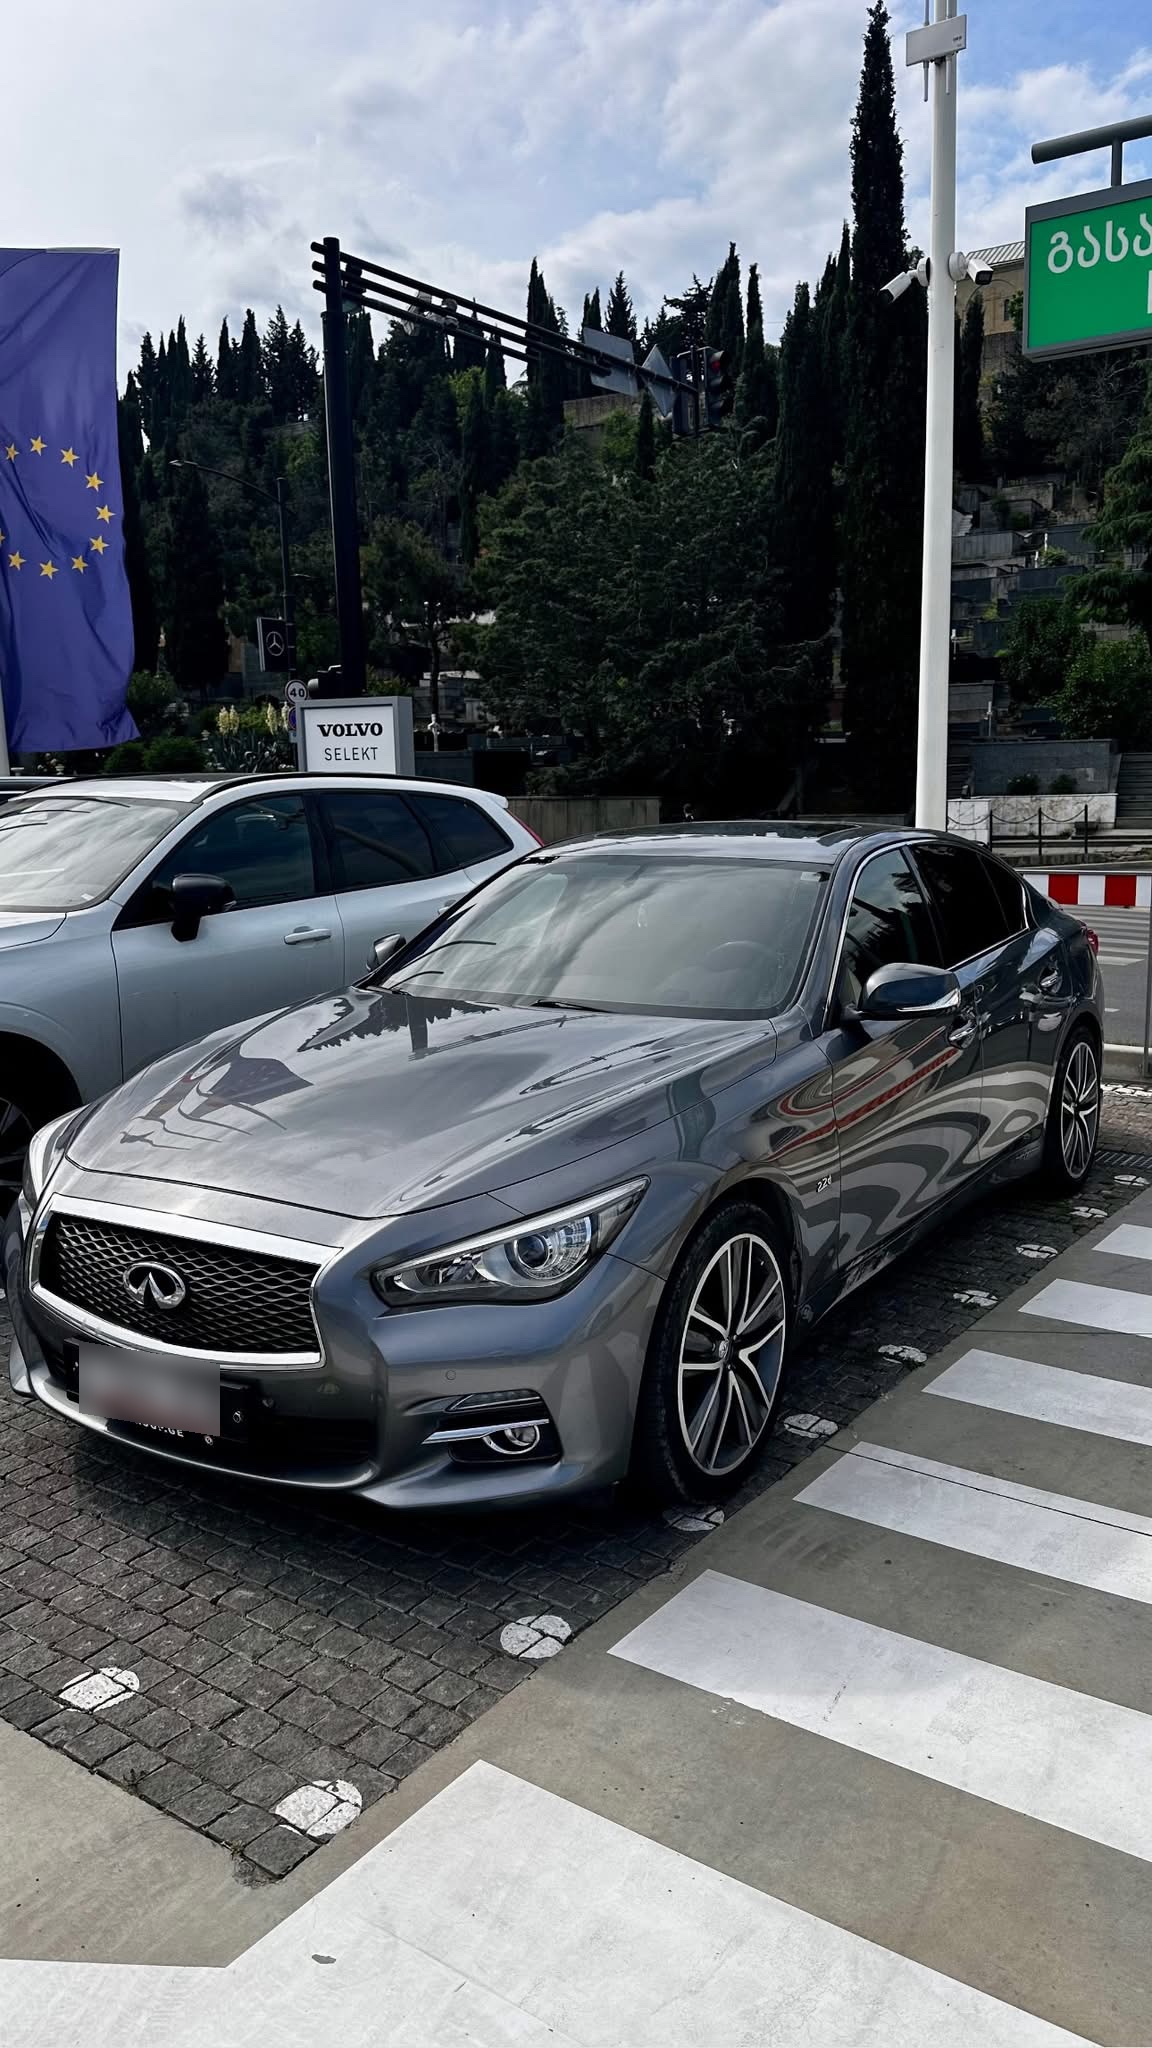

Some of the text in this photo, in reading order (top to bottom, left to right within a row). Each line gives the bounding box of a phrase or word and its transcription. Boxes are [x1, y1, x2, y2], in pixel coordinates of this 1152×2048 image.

[290, 688, 305, 697] 40
[317, 722, 383, 737] VOLVO
[324, 747, 378, 761] SELEKT
